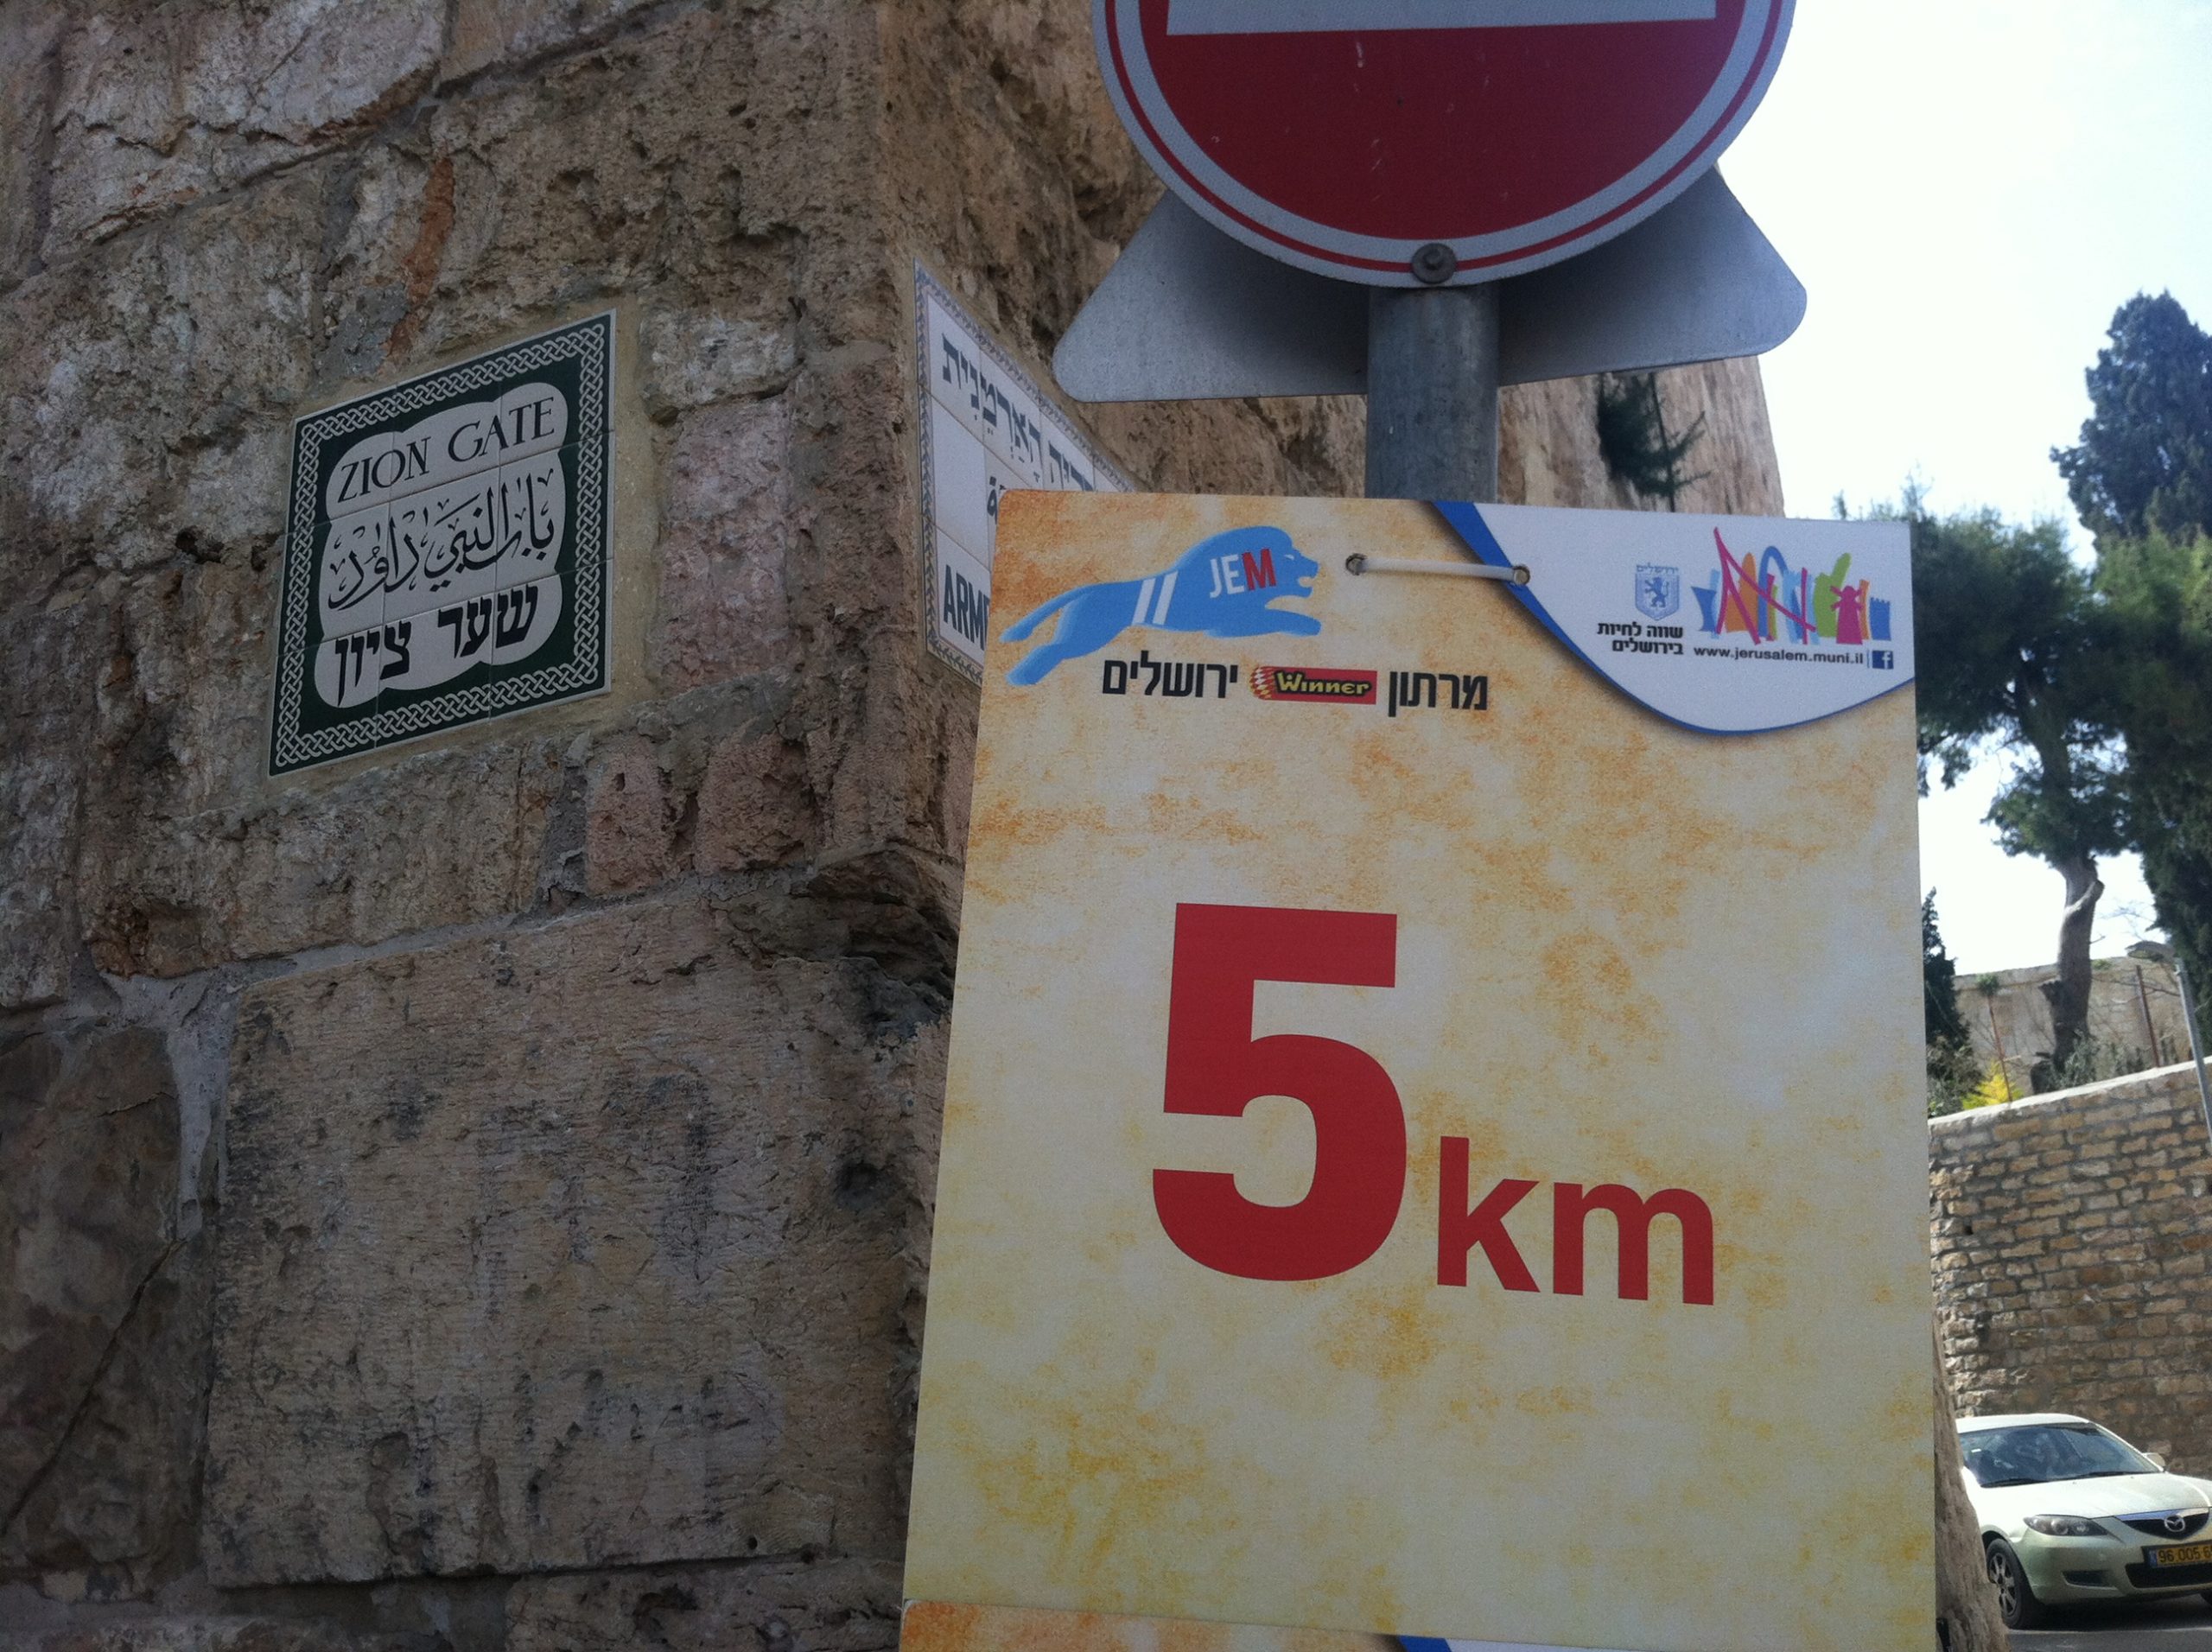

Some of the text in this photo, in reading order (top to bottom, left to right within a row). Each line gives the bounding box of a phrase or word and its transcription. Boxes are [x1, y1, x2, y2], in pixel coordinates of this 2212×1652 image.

[337, 397, 556, 503] ZION GATE
[1210, 549, 1277, 599] JEM
[334, 584, 538, 708] שער ציון
[1597, 621, 1684, 639] שווה לחיות
[1611, 638, 1684, 656] בירושלים
[1694, 646, 1864, 664] www.jerusalem.muni.il
[1103, 651, 1488, 716] מרתון Winner ירושלים
[1152, 902, 1714, 1306] 5 km
